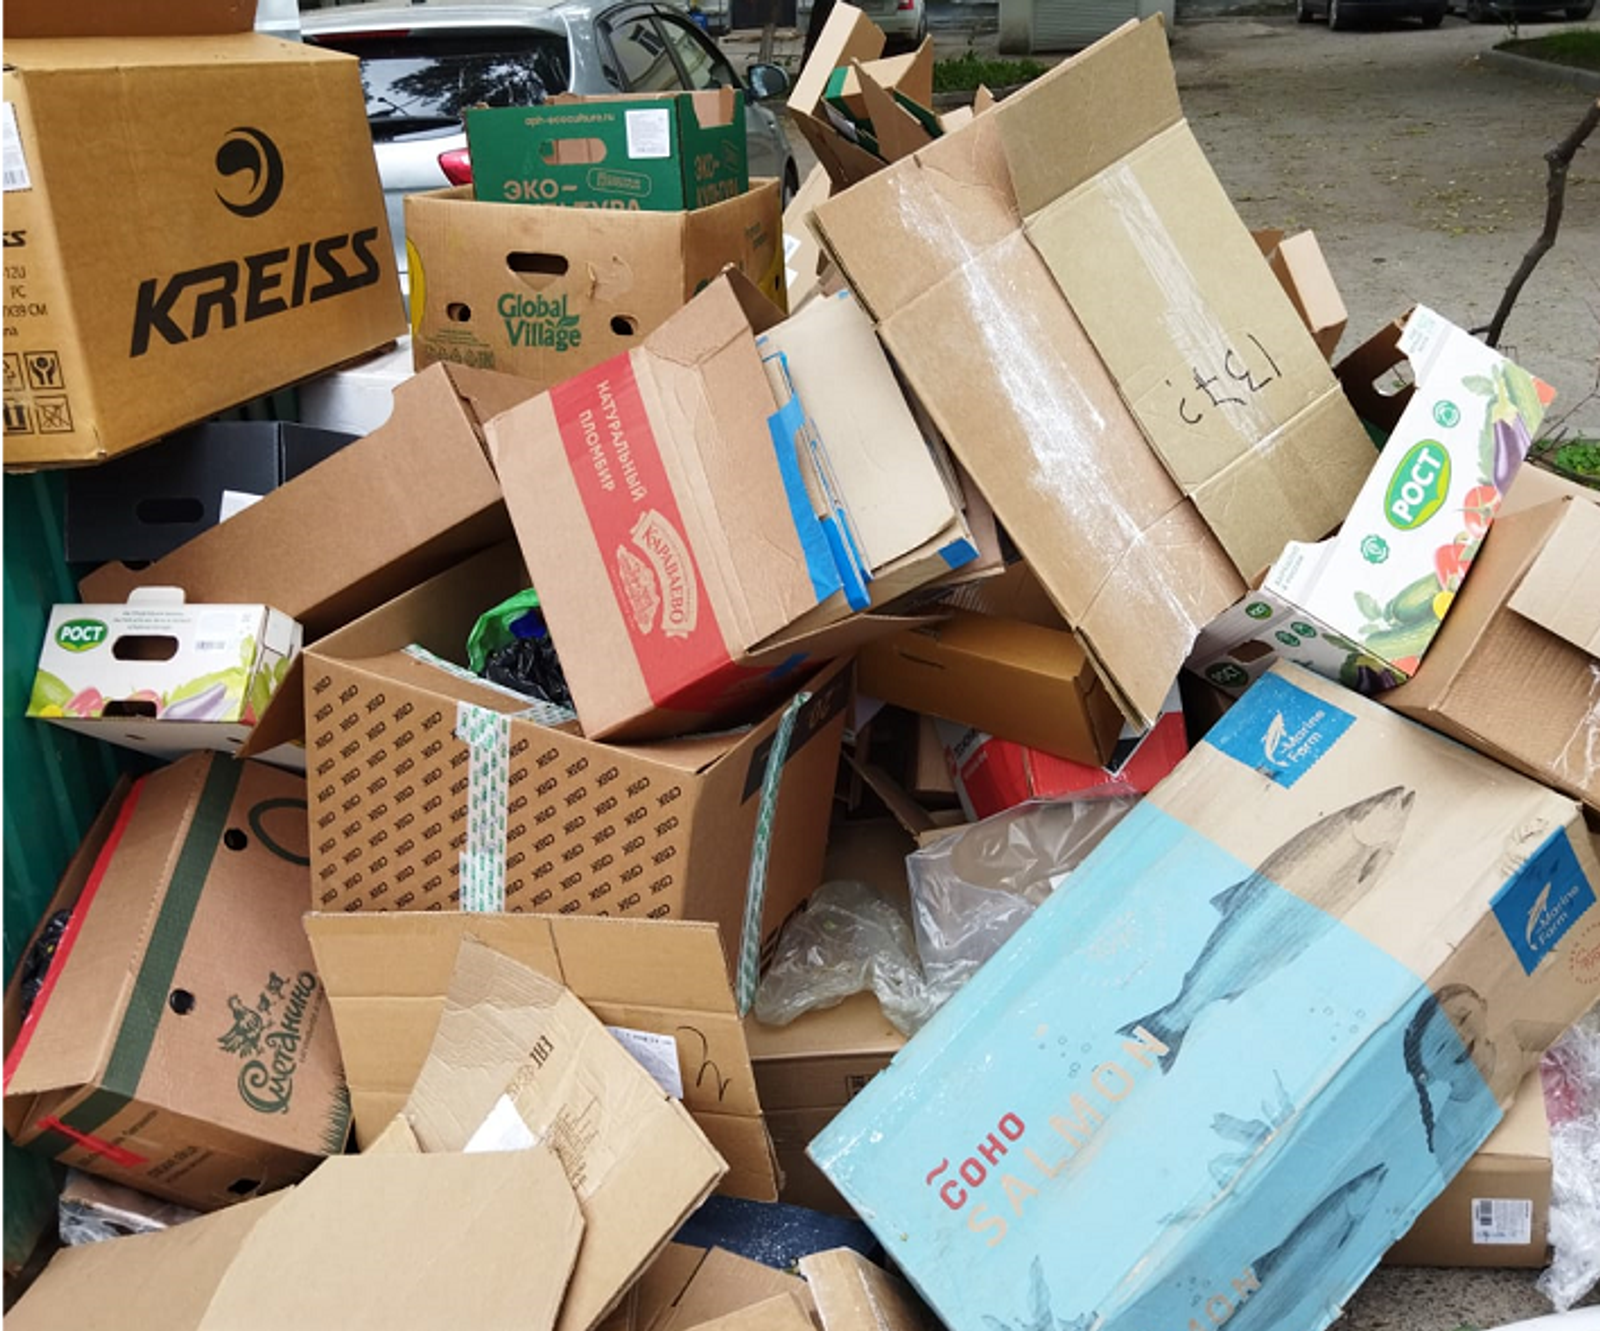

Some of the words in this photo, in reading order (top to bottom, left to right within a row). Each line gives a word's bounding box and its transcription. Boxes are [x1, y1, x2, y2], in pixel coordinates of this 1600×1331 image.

[503, 178, 578, 200] ЭКО-
[129, 226, 382, 359] KREISS
[497, 293, 568, 320] Global
[504, 319, 582, 352] Village
[578, 409, 616, 493] ПЛОМБИР
[597, 379, 648, 503] НАТУРАЛЬНЫЙ
[1391, 448, 1443, 522] РОСТ
[60, 625, 104, 642] РОСТ
[1281, 708, 1326, 753] Marine
[1286, 732, 1323, 765] Farm
[1537, 884, 1580, 931] Marine
[1538, 912, 1570, 947] Farm
[237, 970, 318, 1115] Сметанино
[966, 1024, 1171, 1248] SALMON
